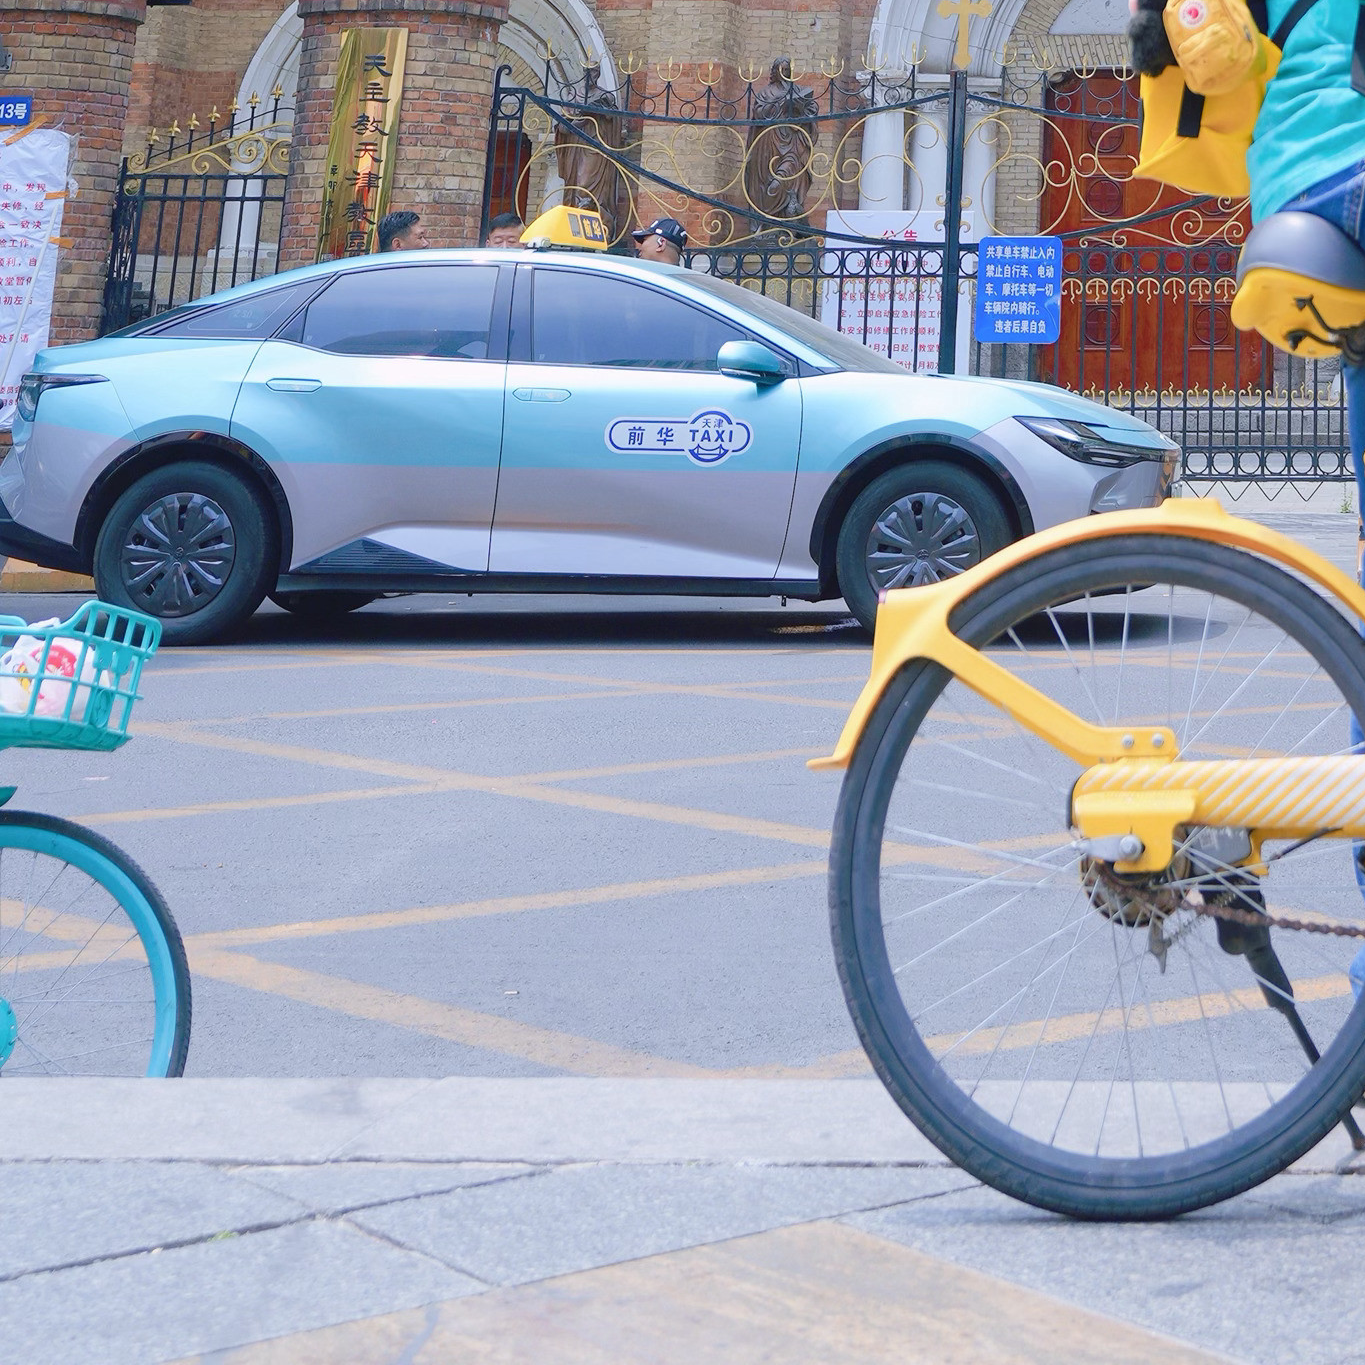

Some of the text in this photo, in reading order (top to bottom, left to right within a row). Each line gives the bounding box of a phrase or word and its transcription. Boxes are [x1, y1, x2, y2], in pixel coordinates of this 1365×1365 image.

[986, 245, 1055, 260] 共享单车禁止入内
[985, 264, 1054, 278] 禁止自行车、电动
[985, 282, 1054, 297] 车、摩托车等一切
[984, 301, 1040, 315] 车辆院内骑行。
[994, 319, 1046, 334] 违者后果自负
[702, 418, 724, 429] 天津
[628, 426, 733, 446] 前华 TAXI
